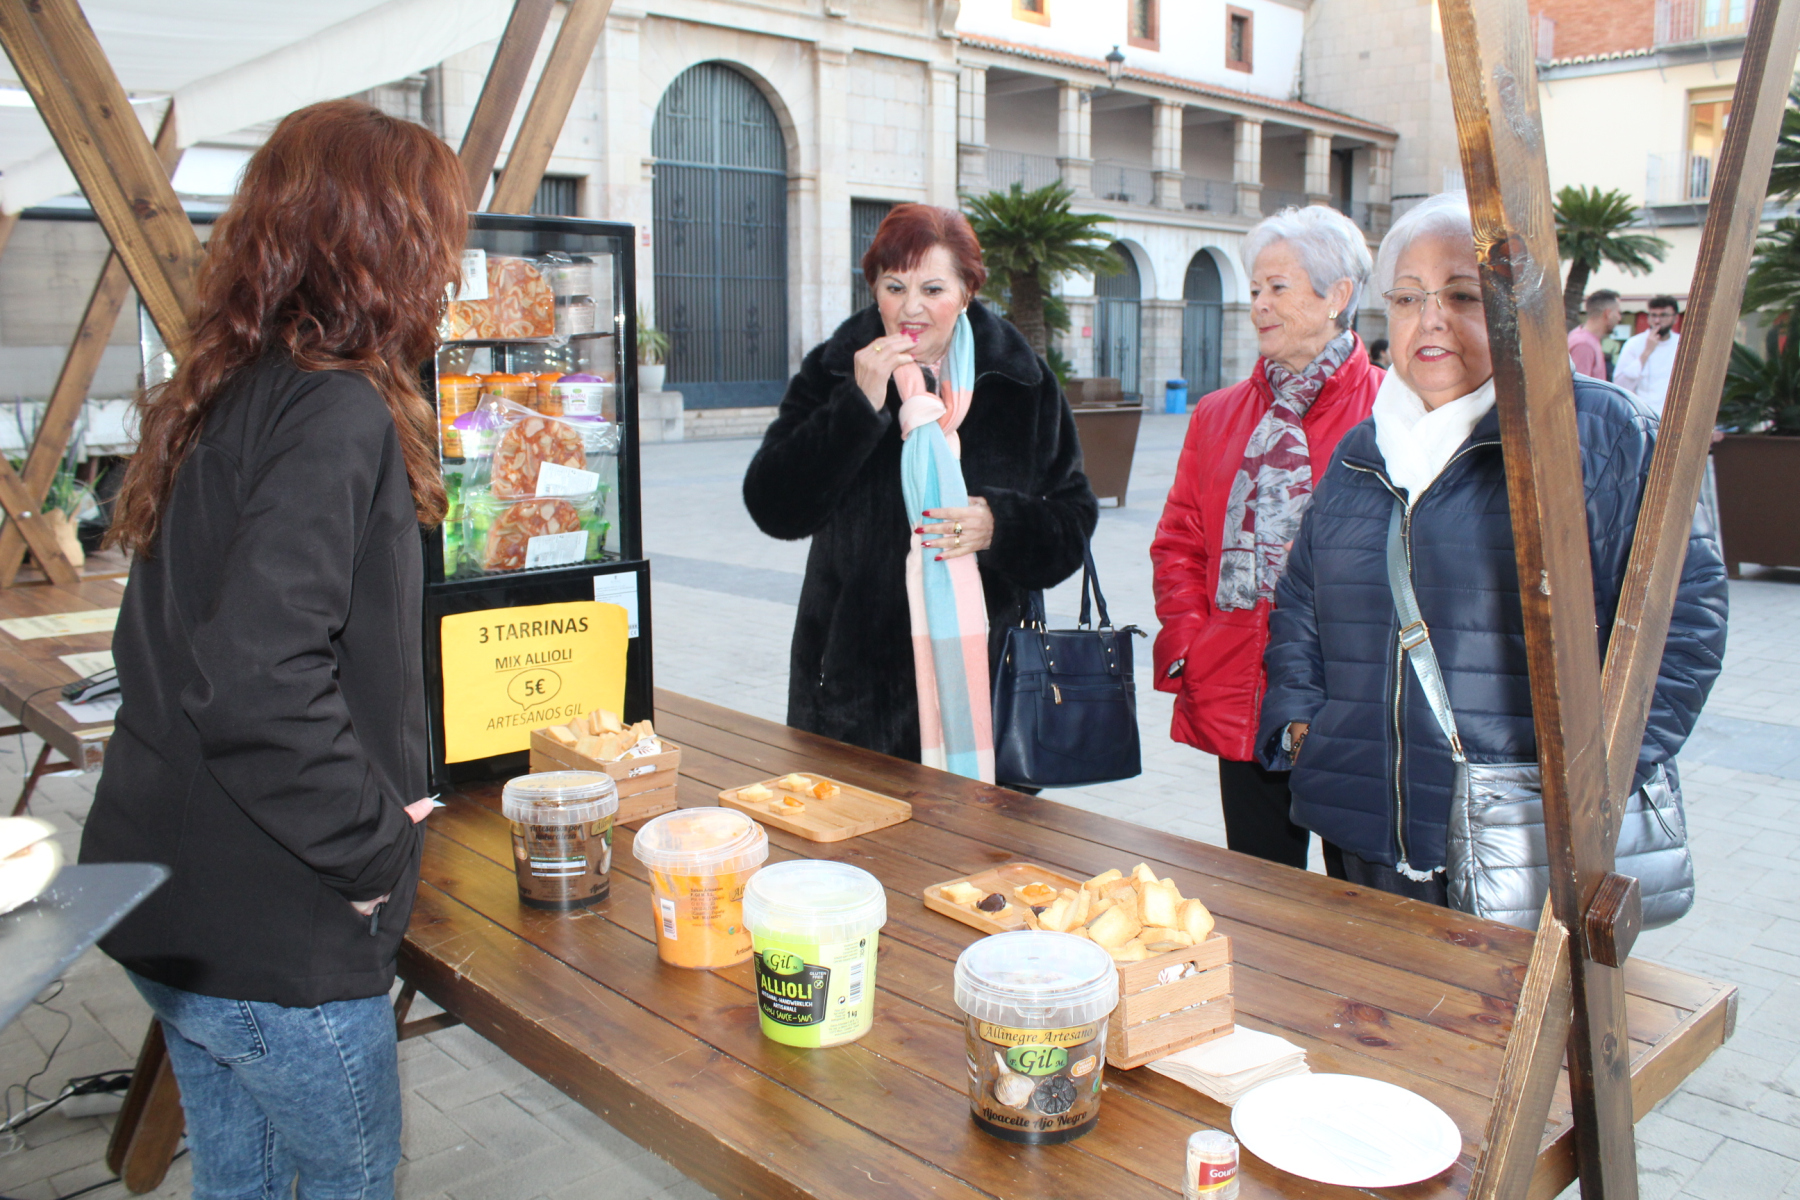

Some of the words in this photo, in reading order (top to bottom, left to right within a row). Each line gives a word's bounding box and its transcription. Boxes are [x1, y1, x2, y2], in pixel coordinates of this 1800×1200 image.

[479, 626, 489, 644] 3
[495, 616, 589, 642] TARRINAS
[495, 656, 521, 670] MIX
[525, 648, 573, 665] ALLIOLI
[524, 678, 546, 696] 5€
[486, 705, 561, 731] ARTESANOS
[564, 703, 583, 717] GIL
[770, 953, 794, 972] Gil
[761, 973, 813, 1000] ALLIOLI
[984, 1026, 1038, 1046] Allinegre
[1040, 1027, 1093, 1044] Artesano
[1019, 1046, 1059, 1074] Gil
[983, 1107, 1030, 1128] Ajoaceite
[1057, 1111, 1088, 1126] Negro
